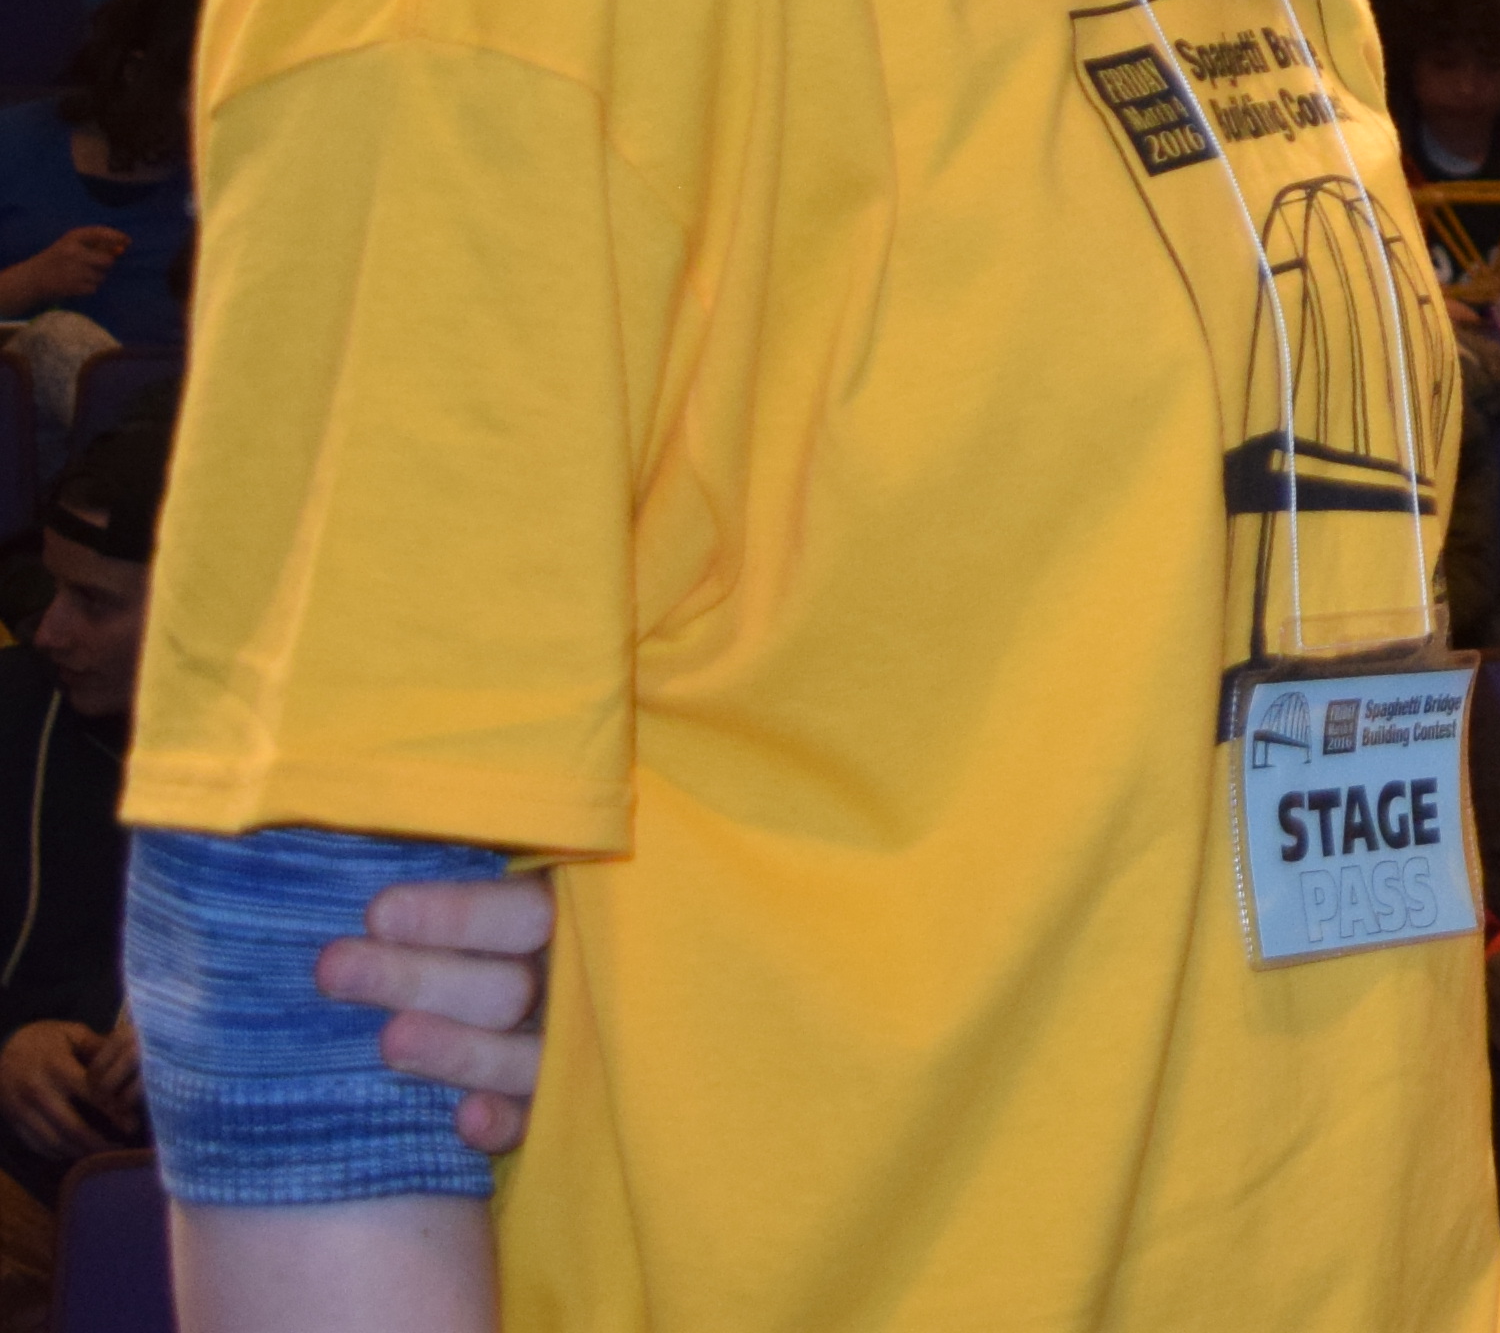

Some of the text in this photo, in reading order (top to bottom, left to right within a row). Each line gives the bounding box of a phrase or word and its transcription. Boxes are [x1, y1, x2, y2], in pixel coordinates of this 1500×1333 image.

[1098, 57, 1169, 104] FRIDAY
[1144, 124, 1206, 164] 2016
[1365, 693, 1462, 722] Spaghetti Bridge
[1362, 724, 1410, 747] Building
[1413, 718, 1457, 742] Contest
[1278, 776, 1441, 863] STAGE
[1300, 856, 1439, 944] PASS
